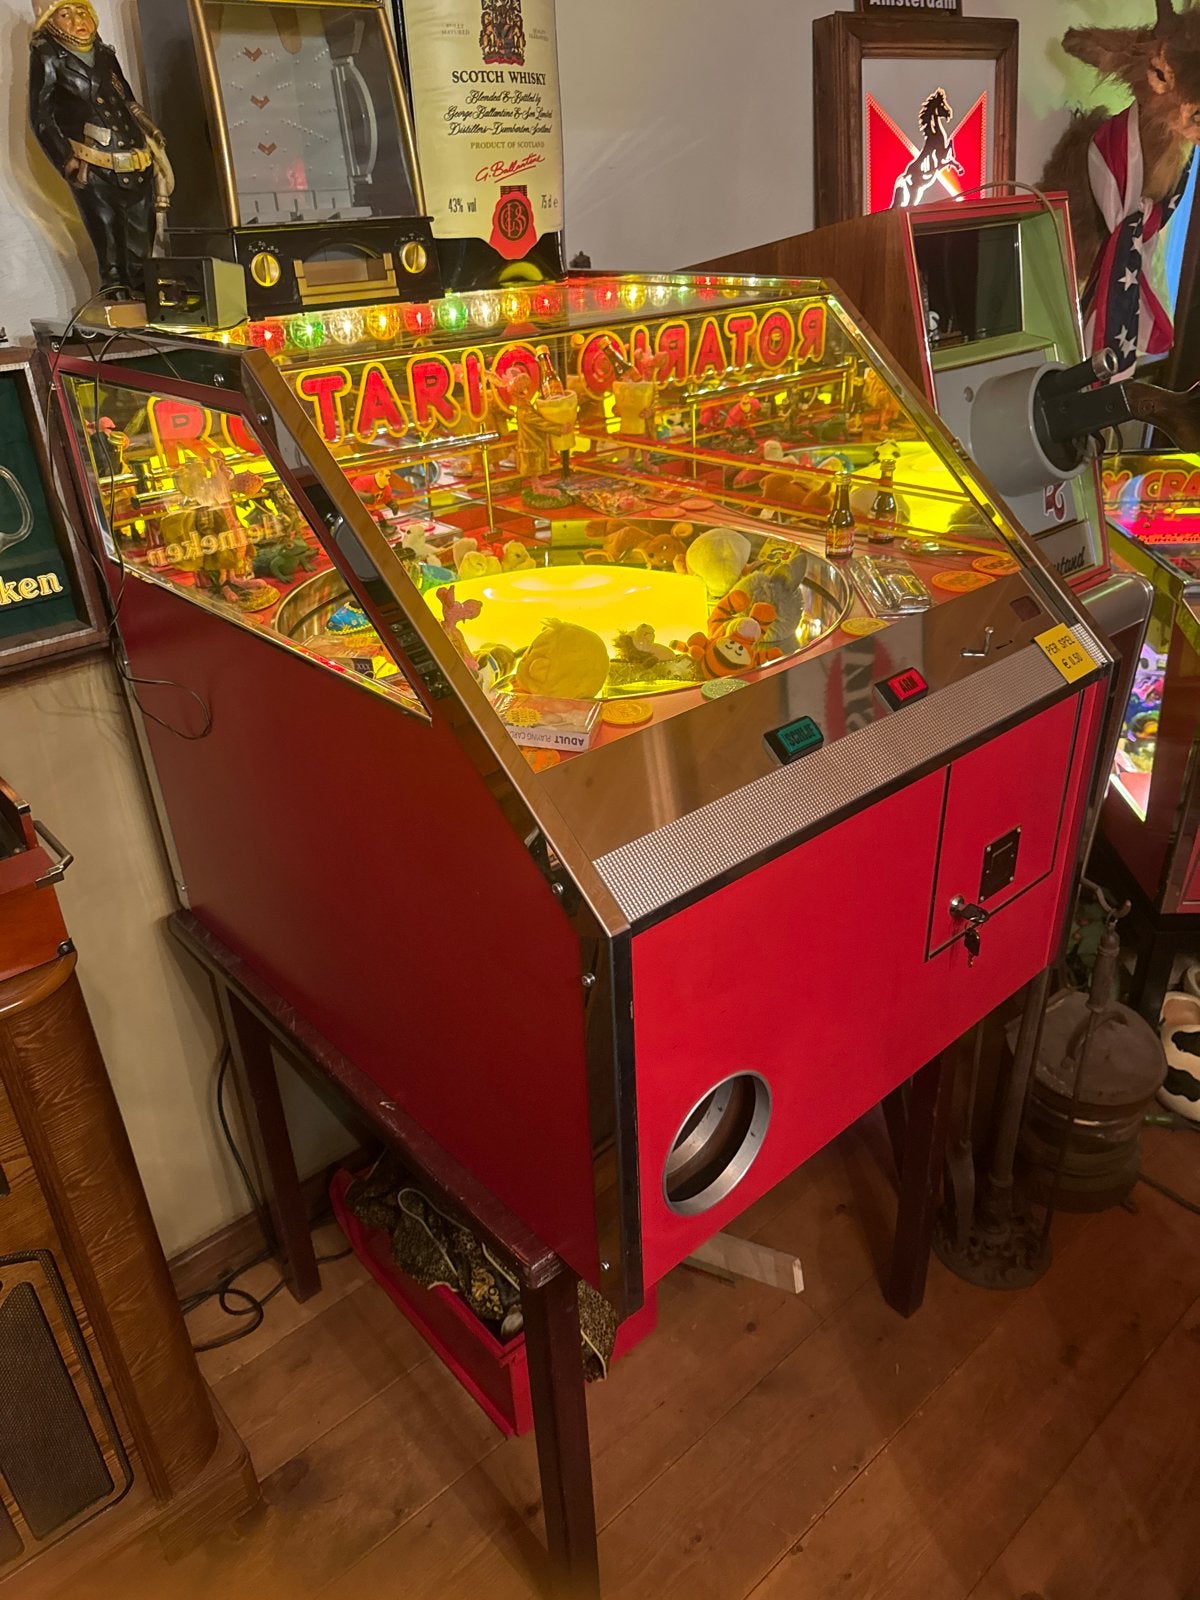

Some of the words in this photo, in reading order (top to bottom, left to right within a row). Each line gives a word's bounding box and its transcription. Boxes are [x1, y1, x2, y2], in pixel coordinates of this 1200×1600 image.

[452, 70, 505, 84] SCOTCH
[507, 71, 546, 86] WHISKY
[470, 141, 505, 149] PRODUCT
[507, 141, 516, 149] OF
[517, 141, 545, 149] SCOTLAND
[448, 197, 464, 213] 43%
[467, 197, 477, 213] vol
[1045, 642, 1061, 656] PER
[1058, 635, 1076, 649] SPEL
[898, 675, 917, 693] ARM
[527, 733, 552, 743] PLAYING
[554, 735, 585, 747] ADULT
